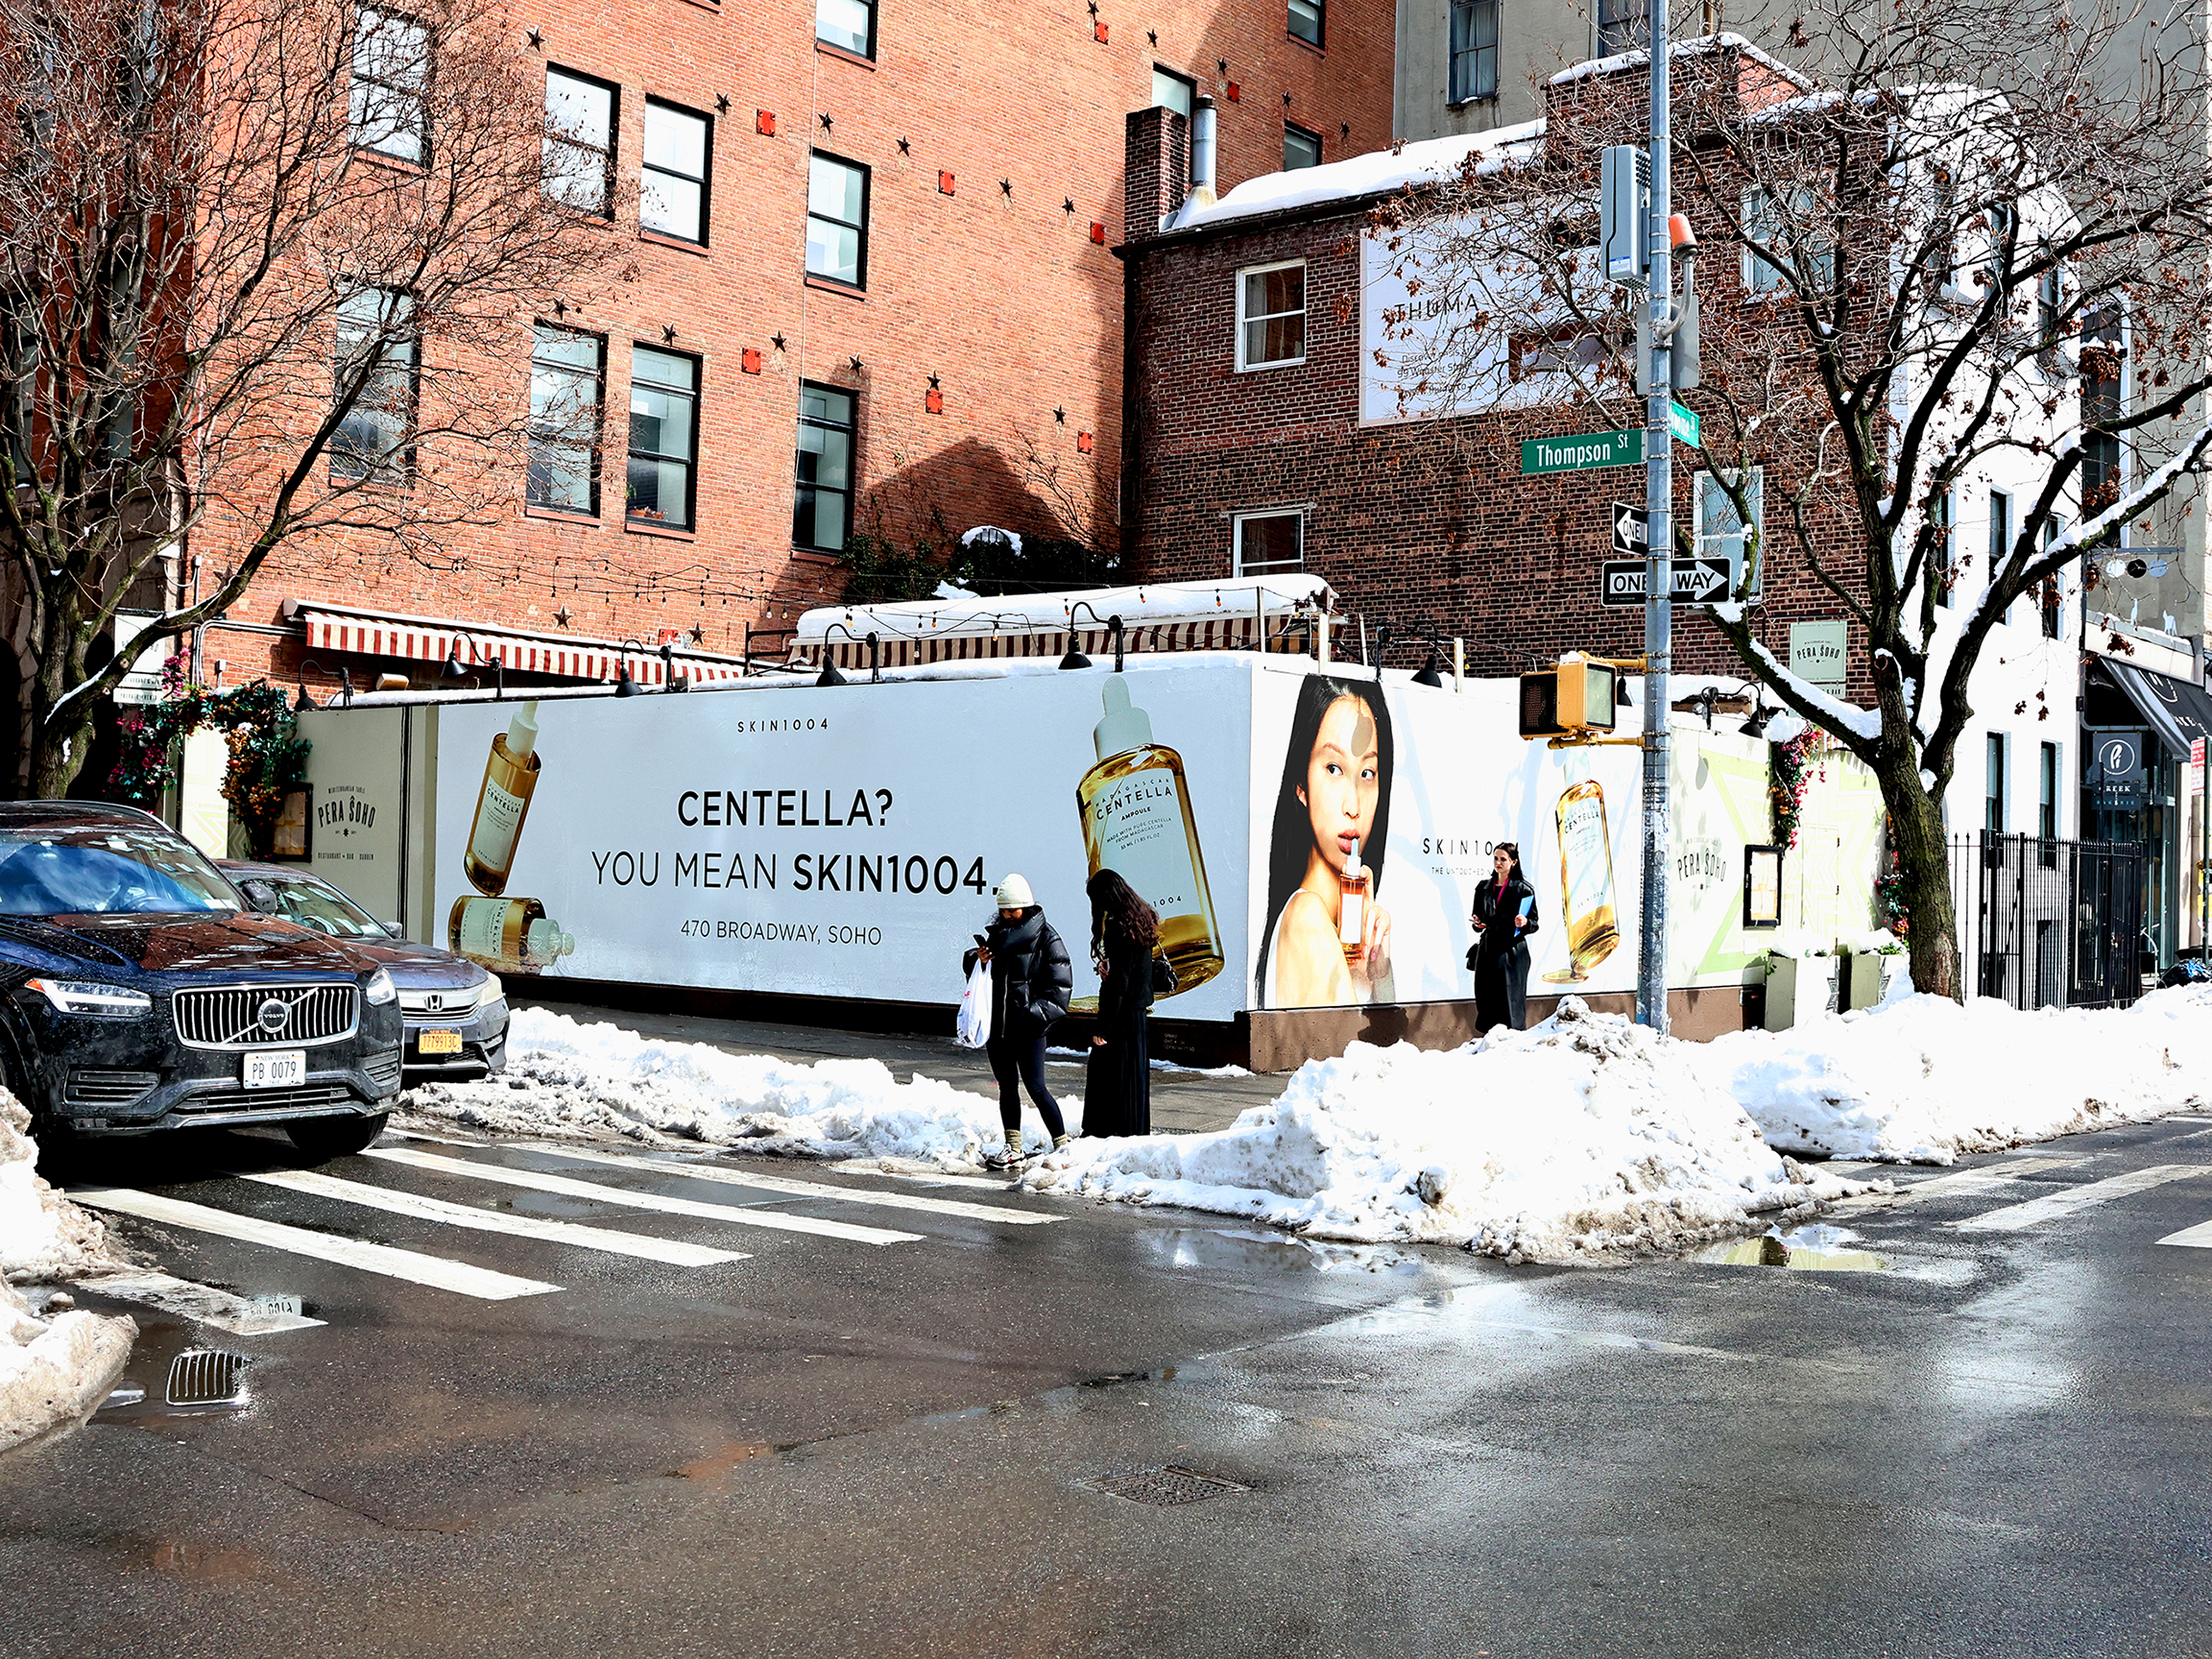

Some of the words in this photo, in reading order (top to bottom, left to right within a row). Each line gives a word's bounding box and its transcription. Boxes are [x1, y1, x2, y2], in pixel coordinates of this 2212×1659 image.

[1394, 293, 1479, 324] THUMA
[1536, 443, 1611, 469] Thompson
[1617, 434, 1628, 448] St
[1623, 519, 1641, 541] ONE
[1675, 572, 1716, 590] WAY
[1796, 646, 1817, 661] PERA
[737, 718, 830, 733] SKIN1004
[486, 787, 519, 814] CENTELLA
[1095, 778, 1170, 807] MADAGASCAR
[1096, 786, 1173, 821] CENTELLA
[318, 800, 345, 829] PERA
[677, 788, 894, 828] CENTELLA?
[1120, 806, 1152, 822] AMPOULE
[1106, 832, 1119, 843] MADE
[1118, 827, 1133, 836] WITH
[1147, 817, 1172, 826] CENTELLA
[1115, 833, 1129, 843] FROM
[1129, 823, 1164, 836] MADAGASCAR
[1564, 811, 1600, 834] CENTELLA
[1423, 837, 1519, 857] SKIN10
[591, 851, 660, 887] YOU
[674, 852, 777, 890] MEAN
[1431, 866, 1444, 876] THE
[1677, 852, 1700, 881] PERA
[1153, 895, 1182, 908] 1004
[680, 920, 710, 939] 470
[716, 921, 822, 945] BROADWAY,
[828, 925, 882, 946] SOHO
[252, 1062, 265, 1080] PB
[271, 1061, 297, 1079] 0079
